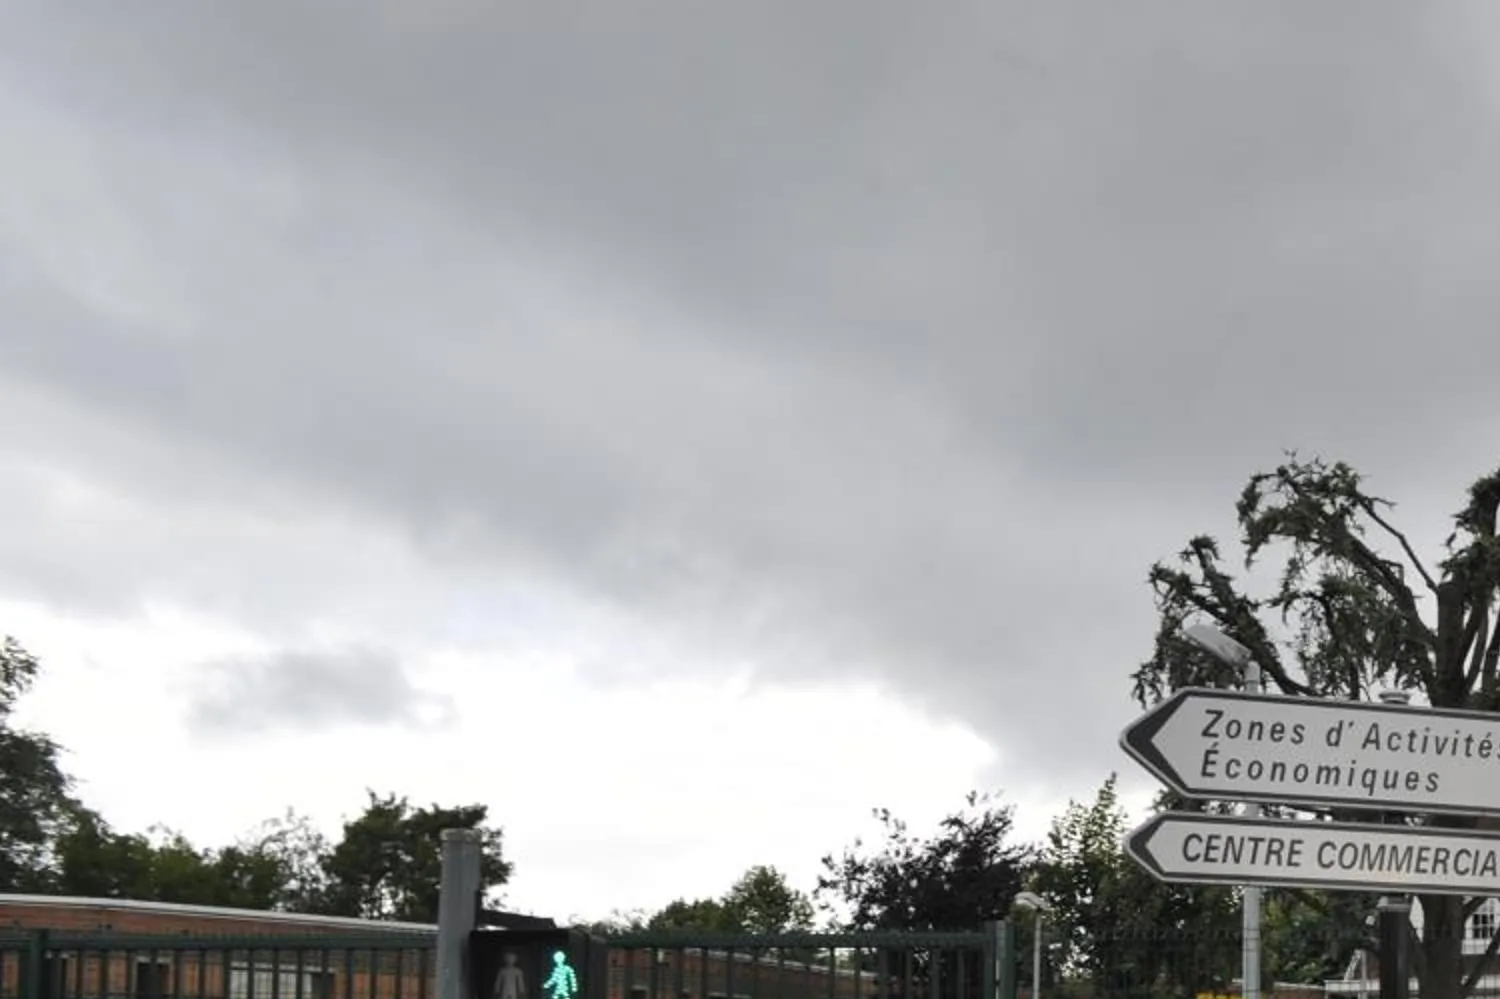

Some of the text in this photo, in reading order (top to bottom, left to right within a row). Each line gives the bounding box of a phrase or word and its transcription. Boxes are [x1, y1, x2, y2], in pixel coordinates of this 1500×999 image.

[1201, 709, 1306, 745] Zones
[1200, 743, 1441, 796] Économiques
[1182, 832, 1304, 867] CENTRE
